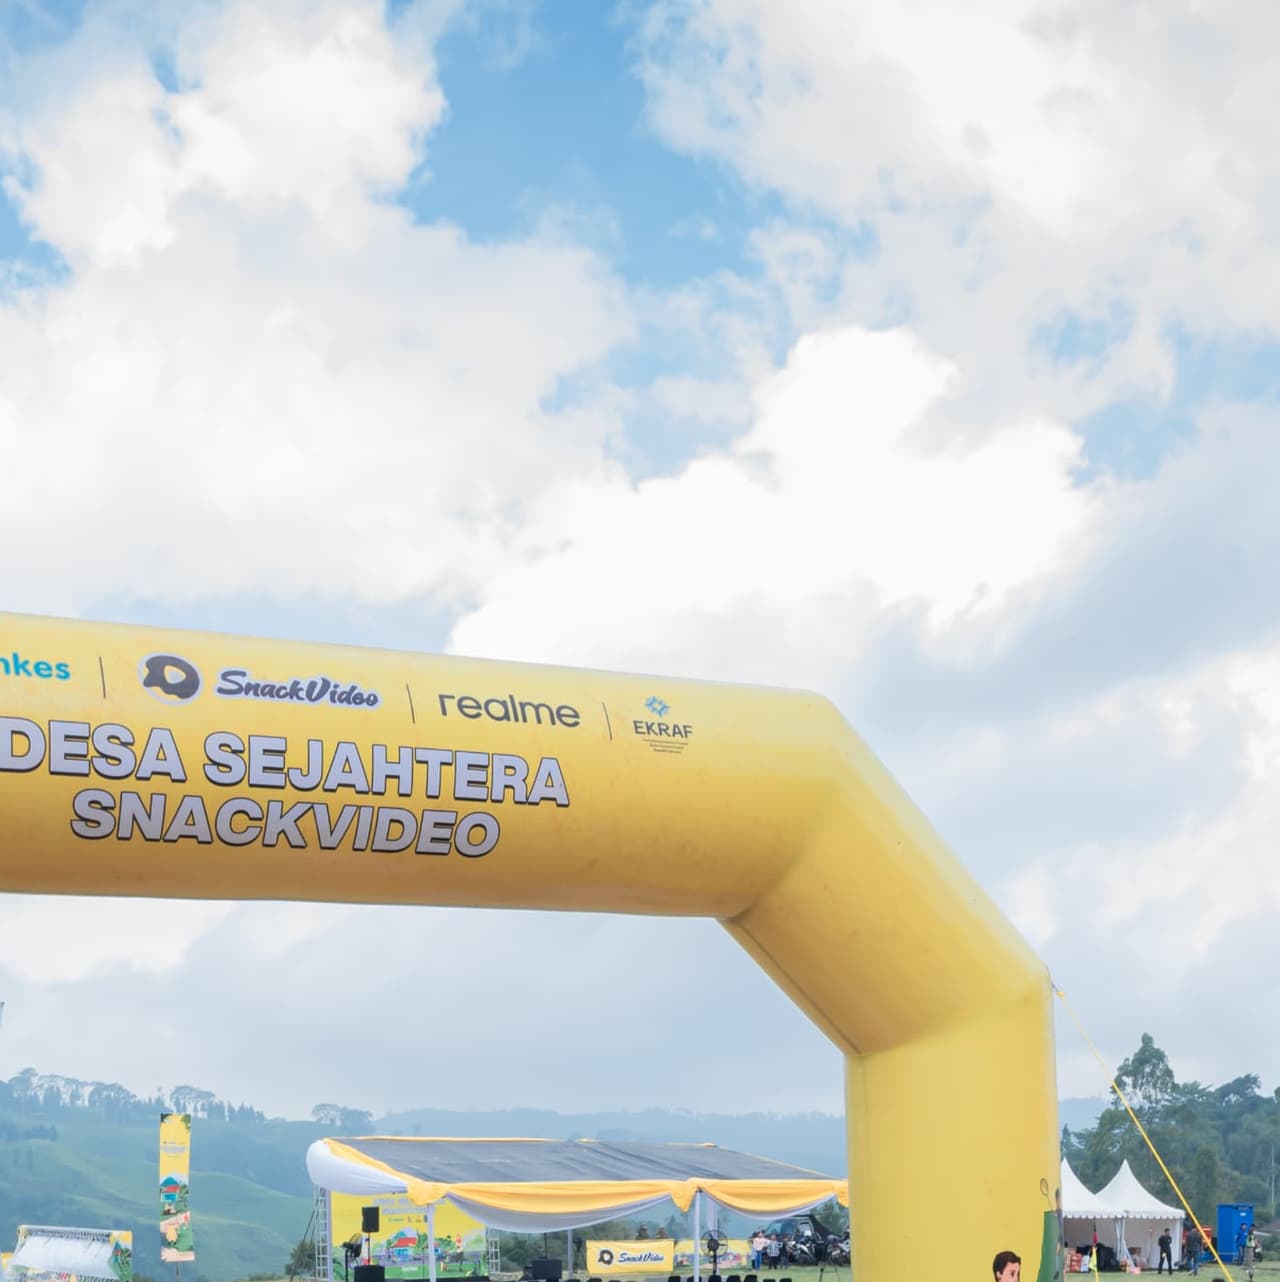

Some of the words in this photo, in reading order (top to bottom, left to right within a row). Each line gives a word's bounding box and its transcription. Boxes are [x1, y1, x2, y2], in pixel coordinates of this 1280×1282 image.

[216, 669, 380, 707] SnackVideo
[438, 694, 581, 728] realme
[632, 719, 694, 740] EKRAF
[203, 731, 571, 807] SEJAHTERA
[70, 787, 501, 858] SNACKVIDEO
